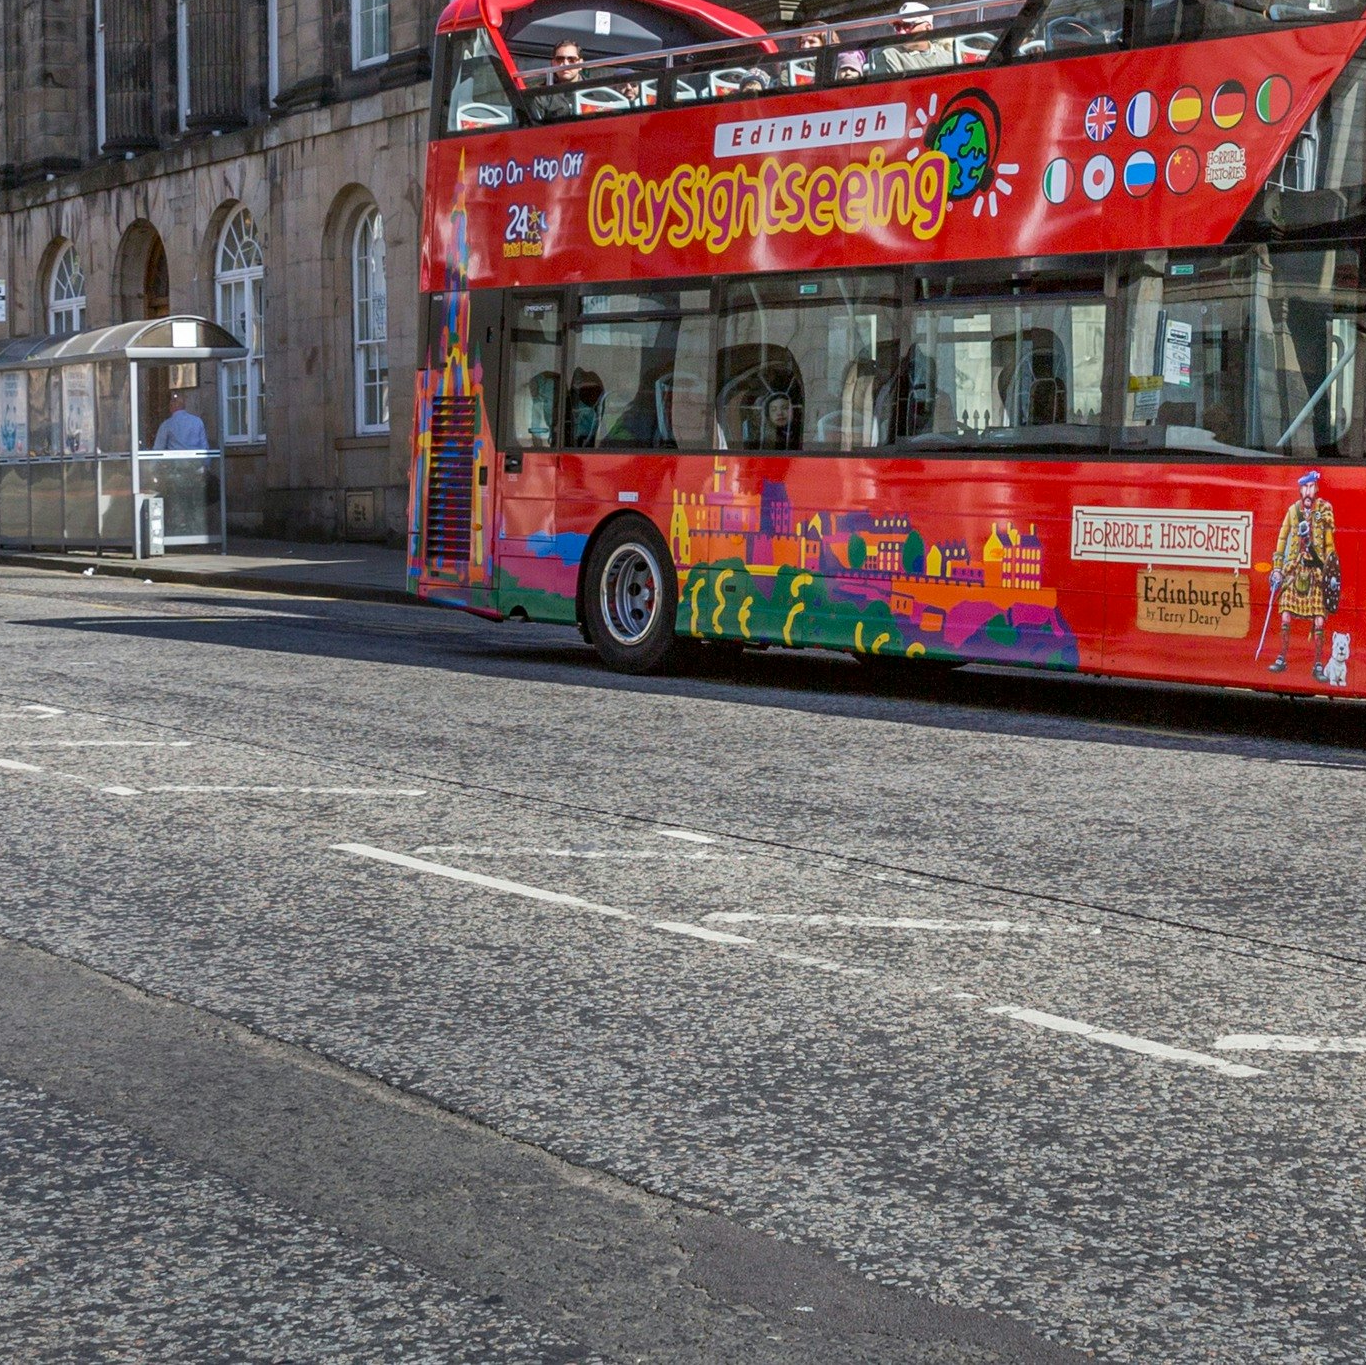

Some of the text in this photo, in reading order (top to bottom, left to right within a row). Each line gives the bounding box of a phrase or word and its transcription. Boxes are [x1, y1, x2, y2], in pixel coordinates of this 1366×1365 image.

[731, 110, 888, 147] Edinburgh
[478, 165, 503, 188] Hop
[506, 160, 523, 184] On
[533, 157, 558, 181] Hop
[562, 152, 584, 177] Off
[1206, 166, 1246, 182] HISTORIES
[1208, 149, 1245, 165] HORRIBLE
[588, 146, 950, 254] CitySightseeing
[505, 204, 528, 240] 24
[1081, 520, 1240, 553] HORRIBLE HISTORIES
[1143, 575, 1244, 616] Edinburgh
[1146, 606, 1221, 631] by Terry Deary
